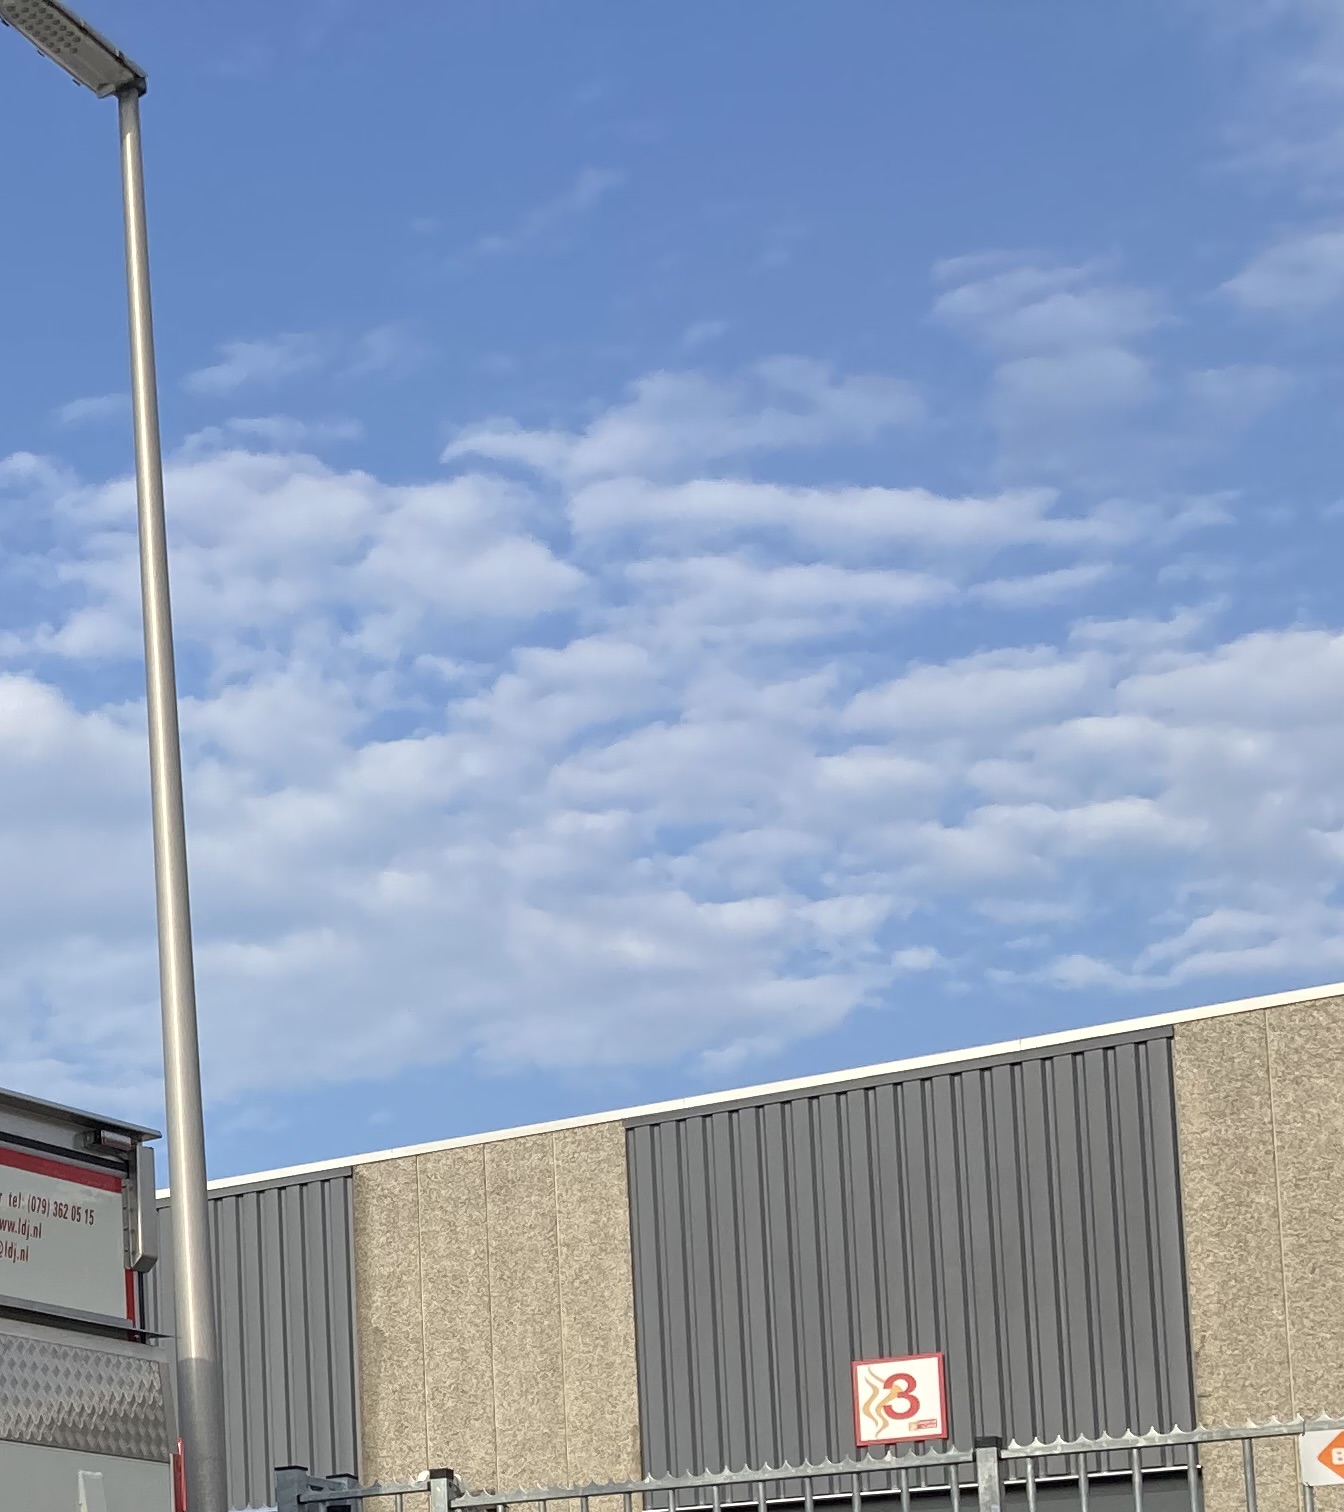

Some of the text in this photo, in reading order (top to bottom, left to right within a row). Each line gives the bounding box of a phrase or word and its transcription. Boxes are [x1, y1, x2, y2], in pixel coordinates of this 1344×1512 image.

[8, 1192, 25, 1209] tel:
[27, 1194, 50, 1218] (079)
[53, 1201, 69, 1220] 362
[71, 1205, 81, 1223] 05
[85, 1208, 95, 1226] 15
[883, 1373, 920, 1420] 3
